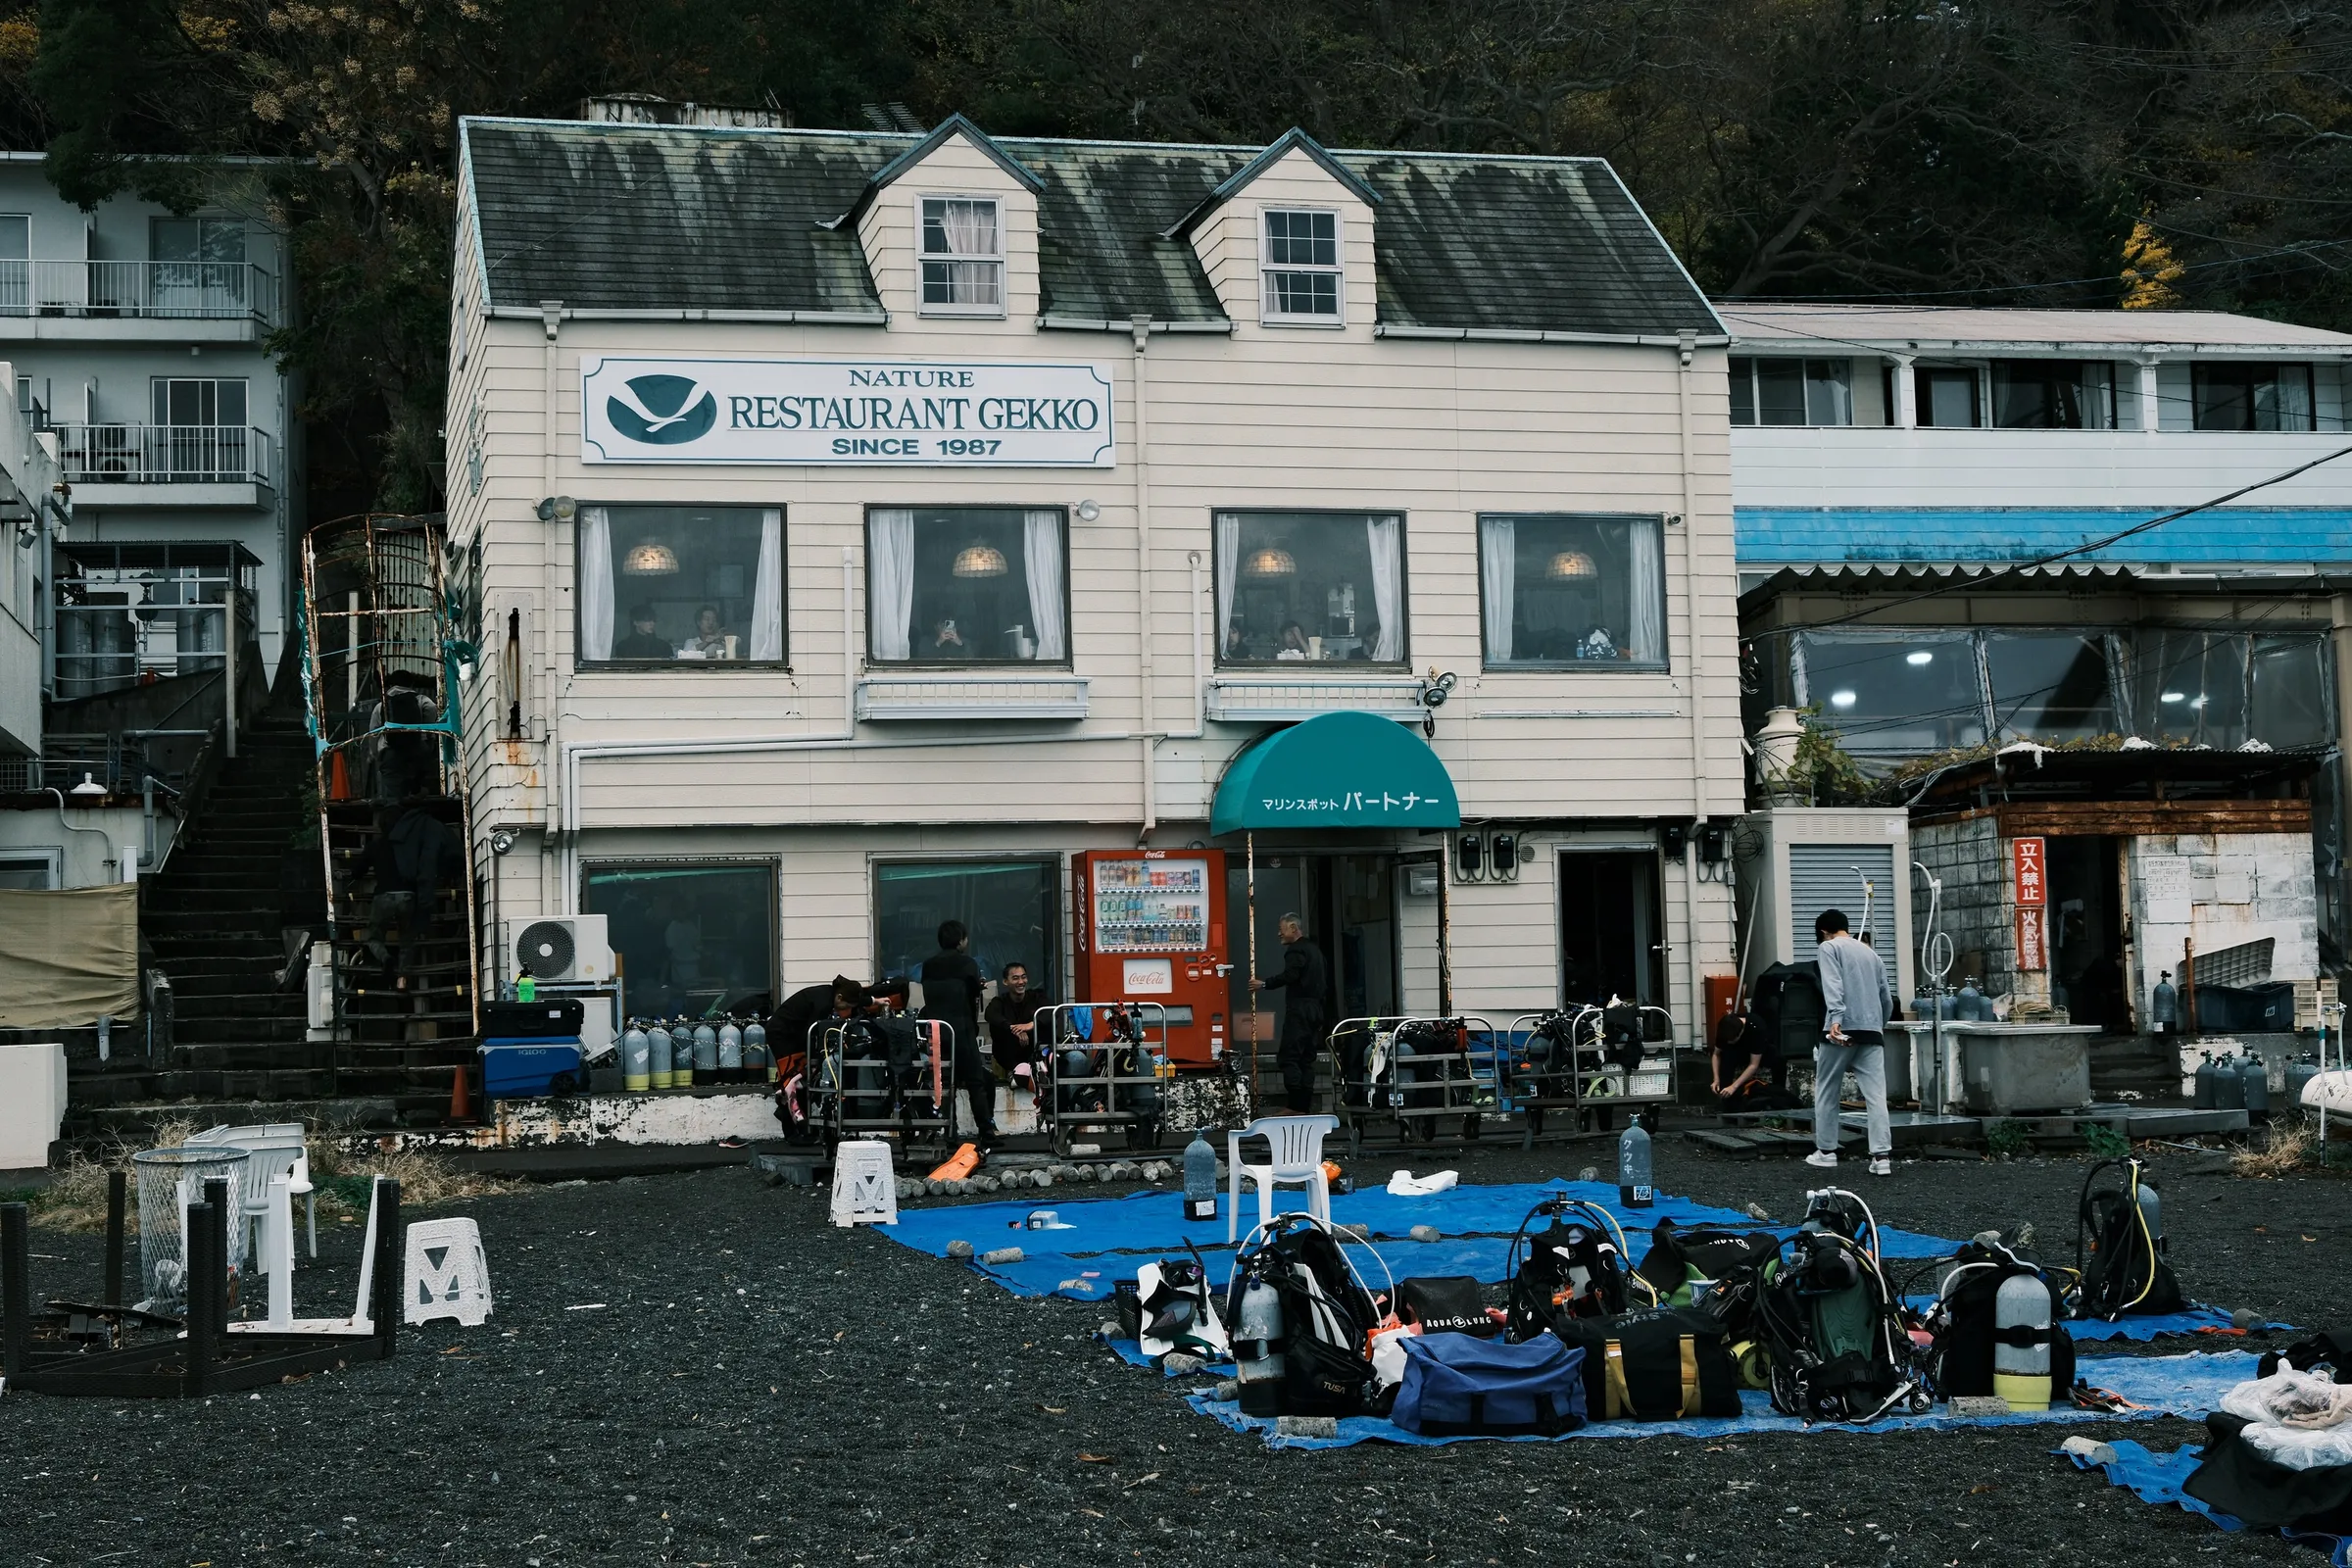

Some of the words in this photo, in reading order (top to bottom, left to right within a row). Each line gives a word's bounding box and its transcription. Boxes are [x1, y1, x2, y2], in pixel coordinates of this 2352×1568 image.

[849, 369, 975, 388] NATURE
[730, 396, 969, 431] RESTAURANT
[978, 398, 1099, 431] GEKKO
[831, 438, 919, 456] SINCE
[936, 439, 1002, 456] 1987
[1262, 799, 1339, 810] マリンスポット
[1344, 791, 1439, 810] パートナー
[2020, 843, 2039, 900] 立入禁止
[1129, 972, 1164, 986] Coca-Cola
[1623, 1139, 1633, 1174] クウキ
[1426, 1319, 1451, 1328] AQUA
[1466, 1316, 1492, 1326] LUNG
[1323, 1381, 1346, 1395] TUSA
